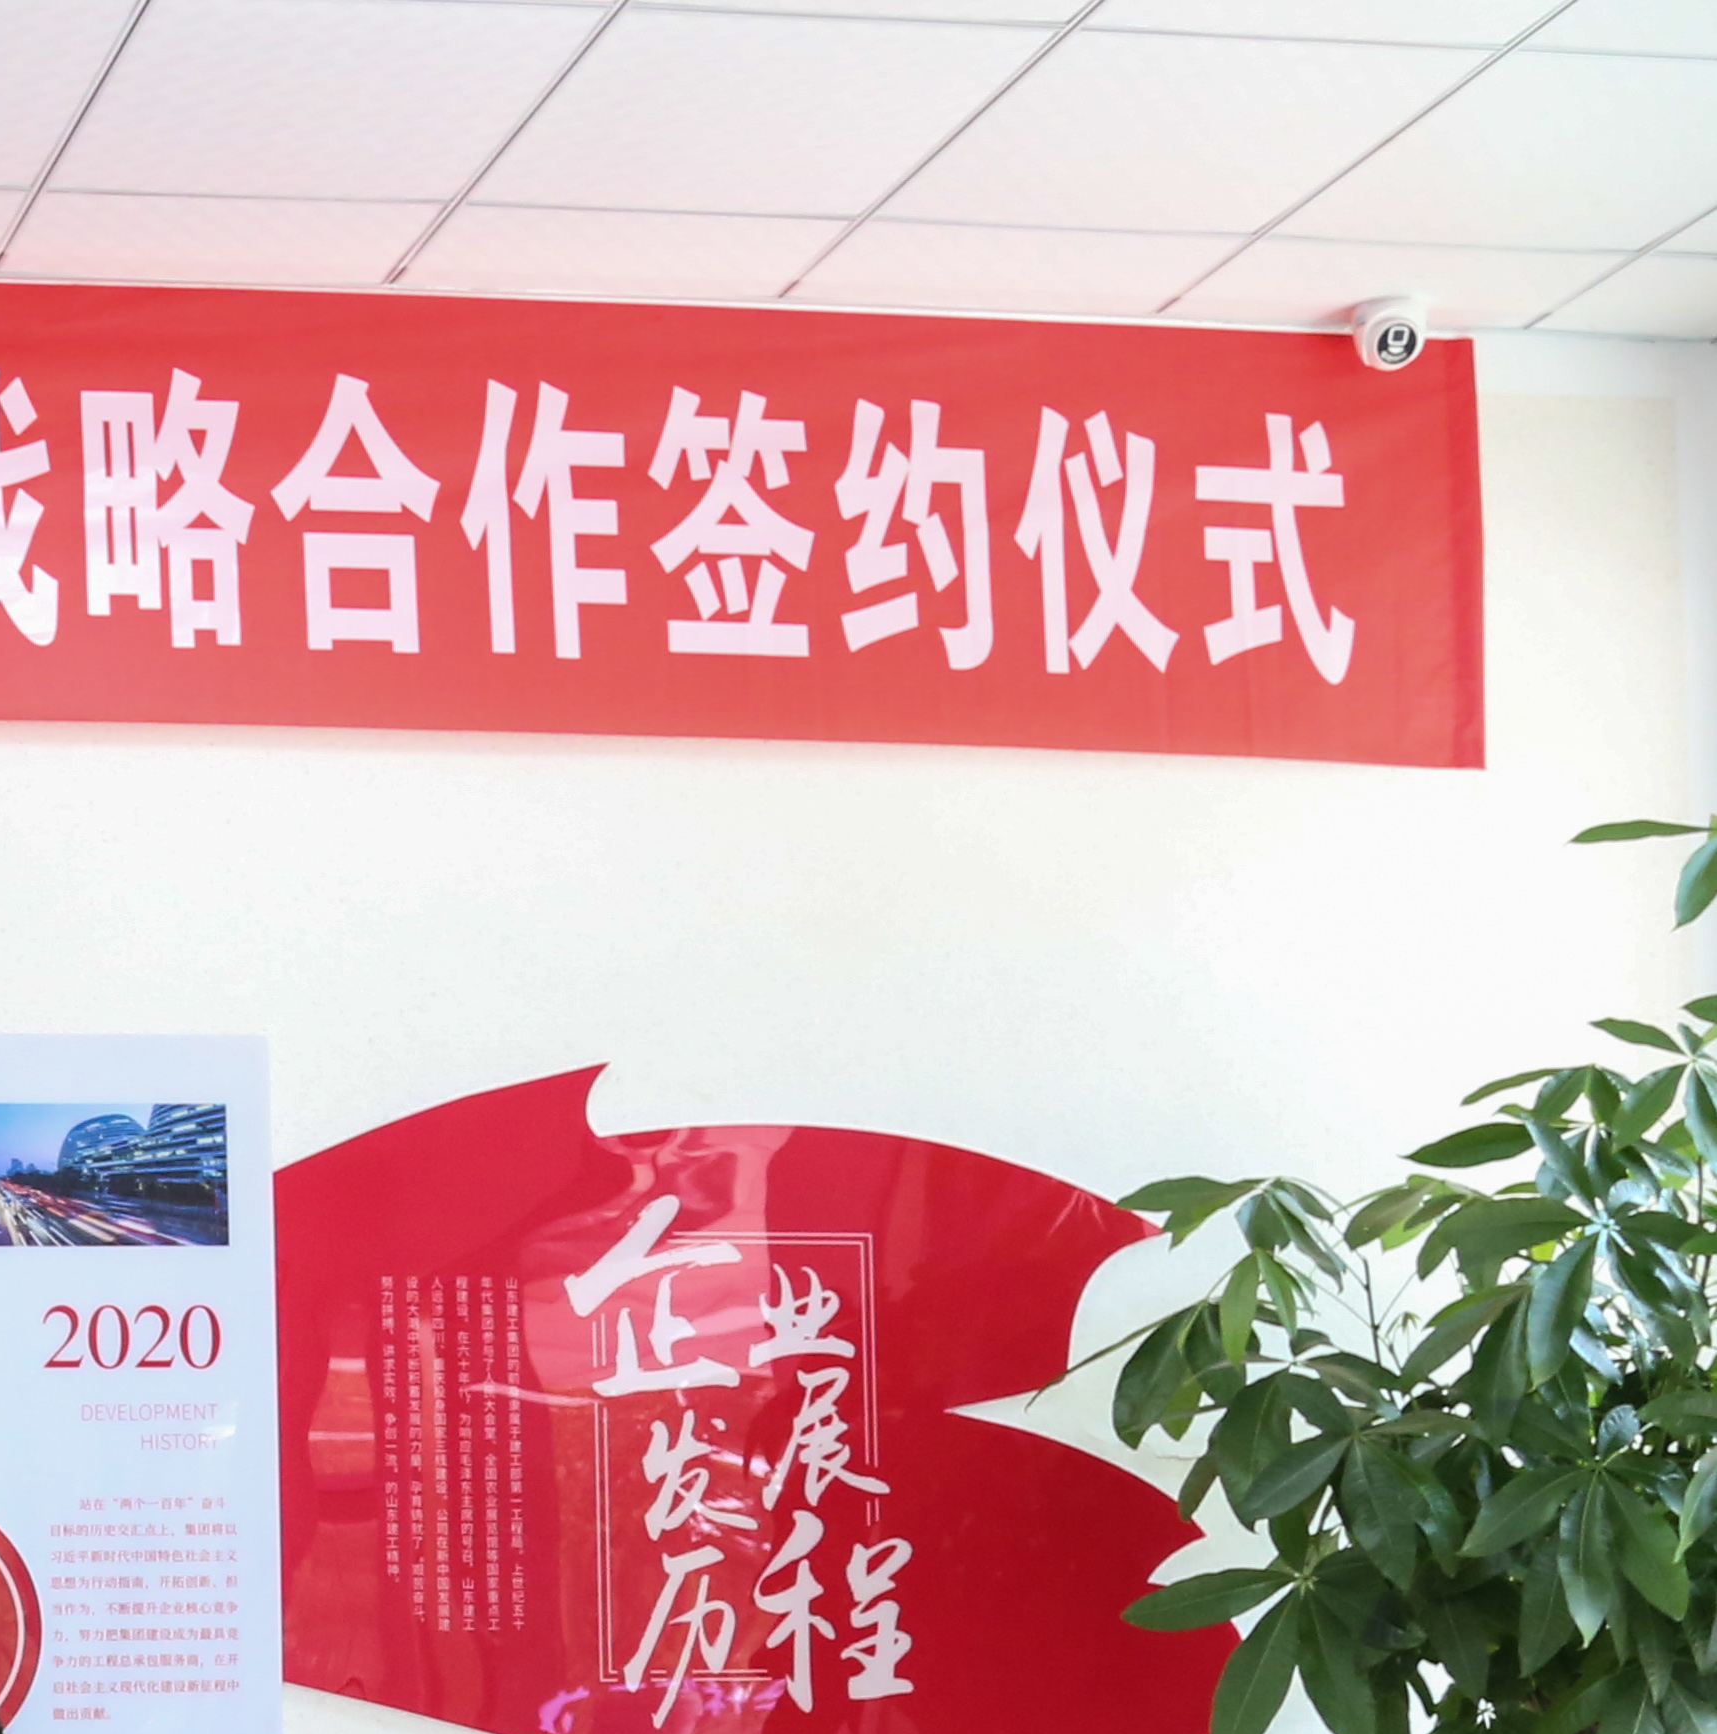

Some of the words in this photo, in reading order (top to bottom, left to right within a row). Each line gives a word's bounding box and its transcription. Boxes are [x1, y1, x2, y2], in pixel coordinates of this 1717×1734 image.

[44, 1305, 221, 1370] 2020
[81, 1403, 218, 1421] DEVELOPMENT
[141, 1434, 219, 1451] HISTORY
